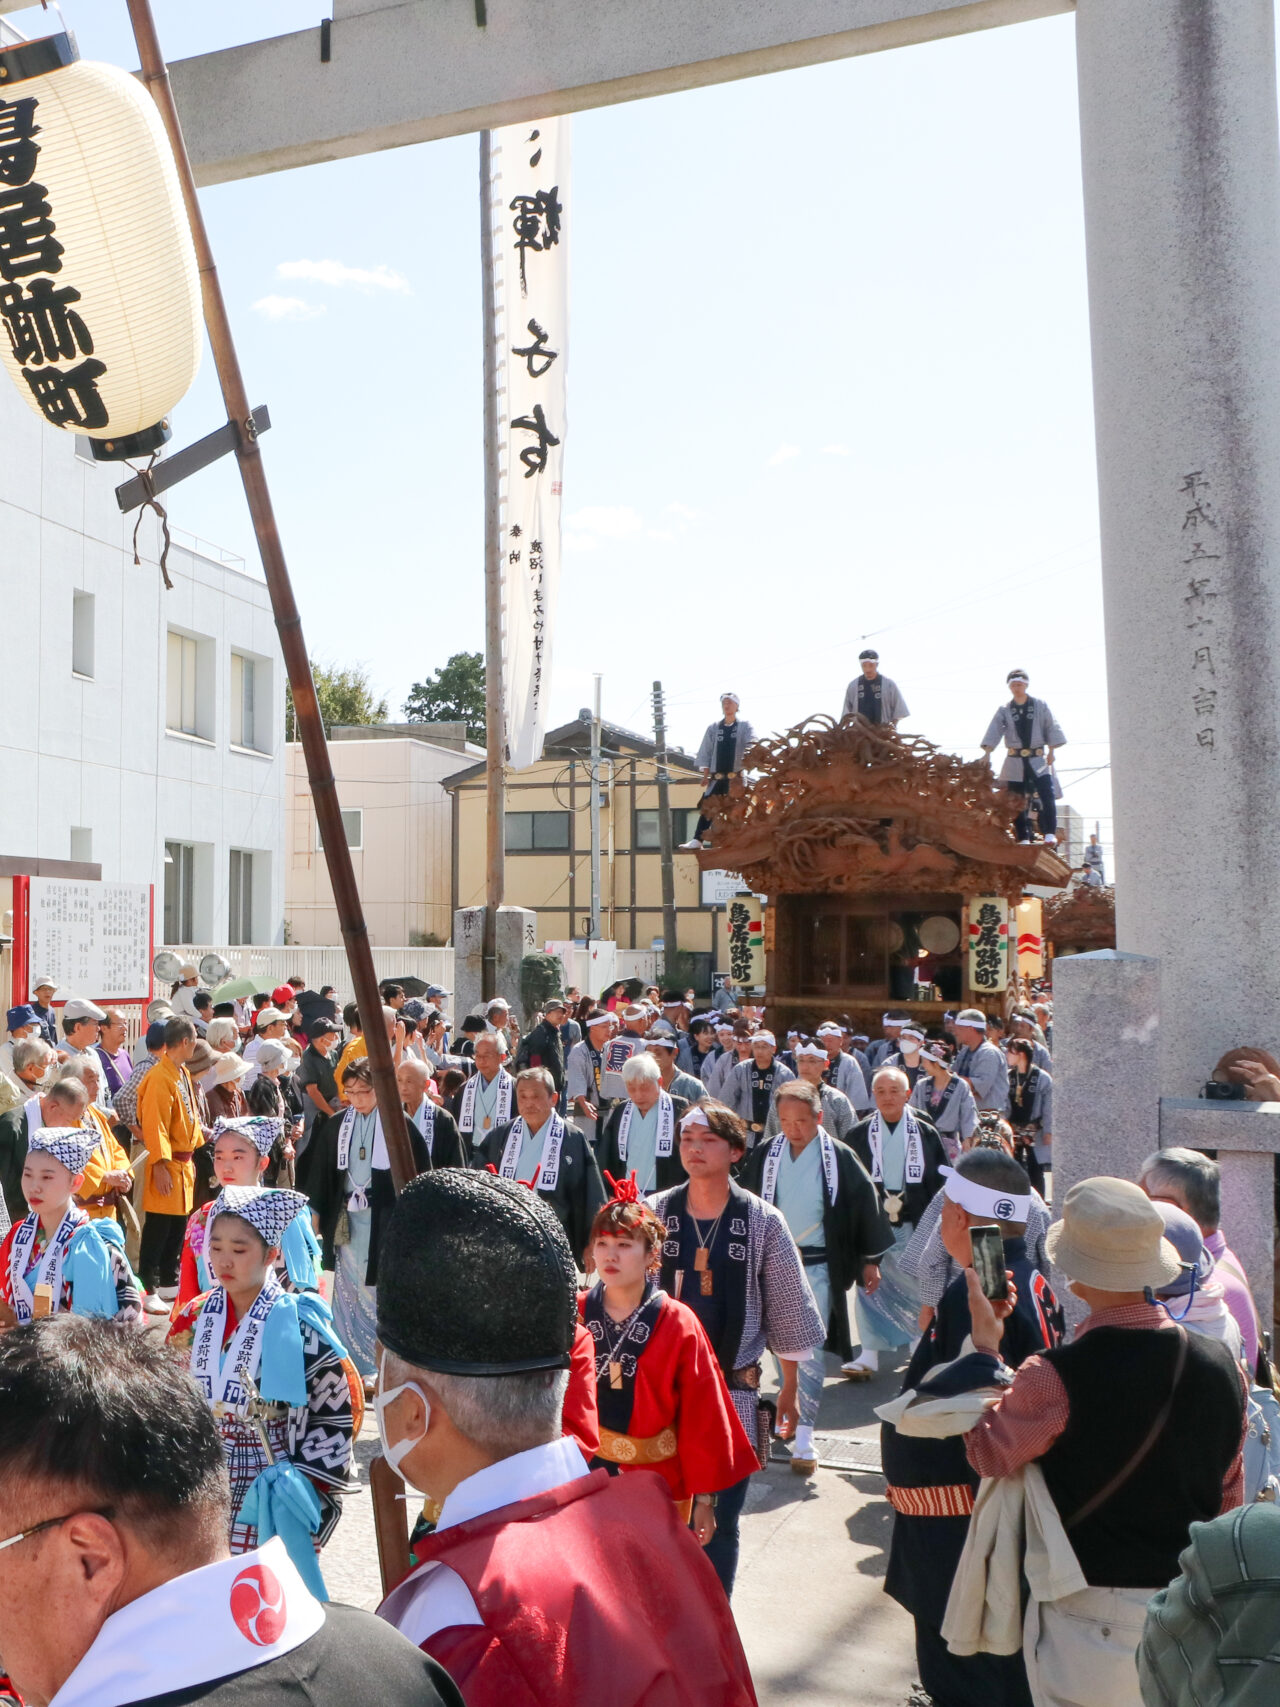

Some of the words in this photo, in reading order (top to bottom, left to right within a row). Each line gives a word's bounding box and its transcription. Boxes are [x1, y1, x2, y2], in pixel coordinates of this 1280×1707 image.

[729, 902, 752, 983] 鳥居跡町
[974, 903, 1002, 989] 鳥居跡町
[196, 1316, 214, 1370] 鳥居跡町
